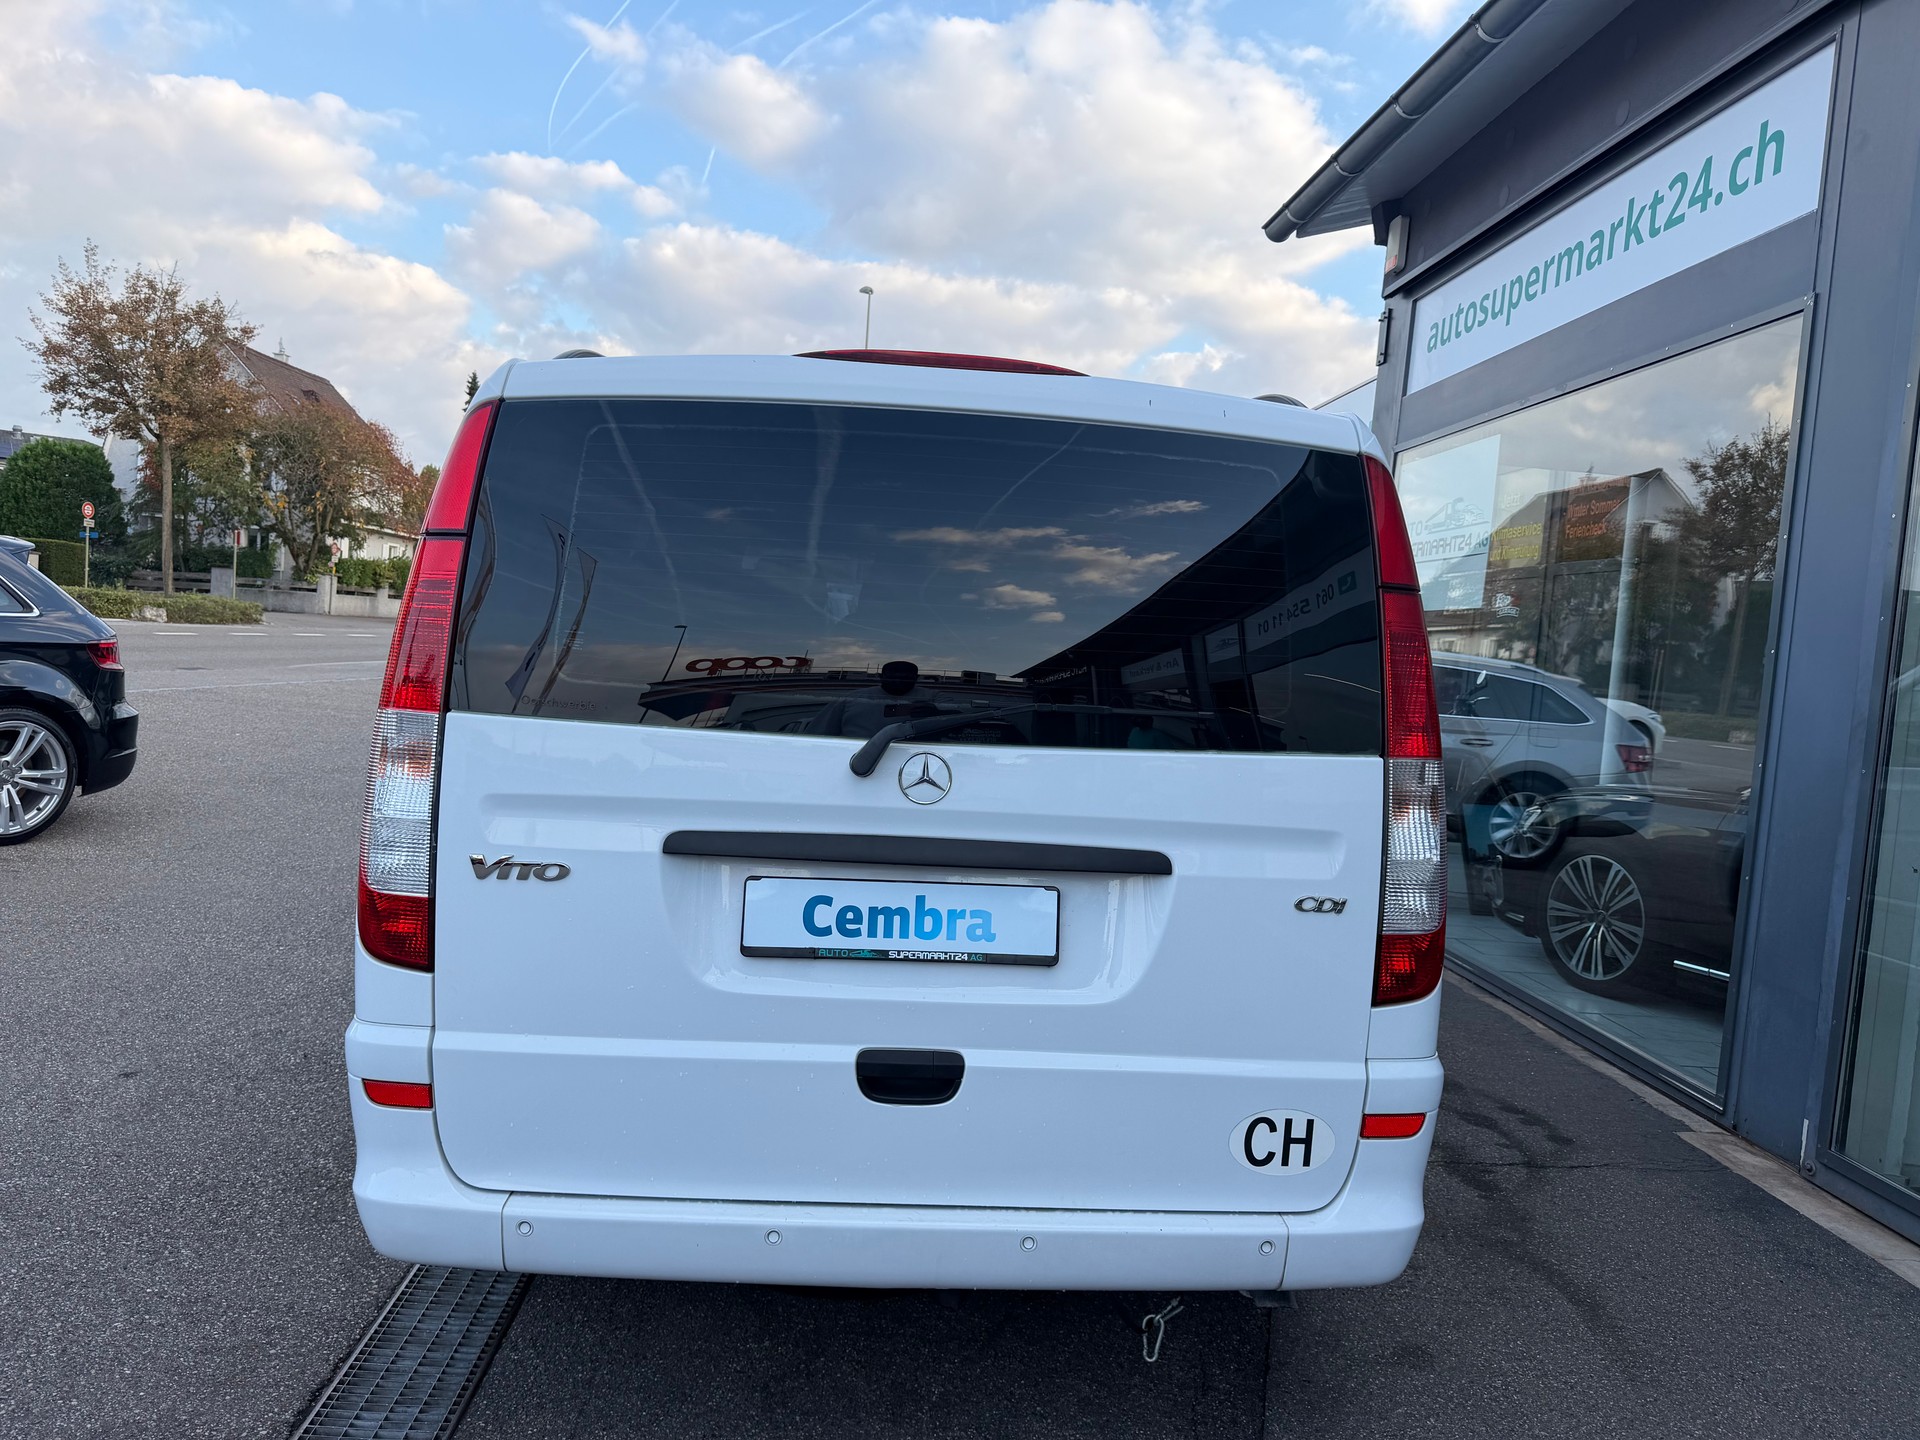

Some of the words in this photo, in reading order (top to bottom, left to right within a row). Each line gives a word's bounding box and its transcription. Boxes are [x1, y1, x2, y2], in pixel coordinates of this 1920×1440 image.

[1426, 119, 1785, 354] autosupermarkt24.ch
[802, 894, 996, 943] Cembra
[818, 948, 849, 958] AUTO
[888, 950, 968, 962] SUPERMARKT24
[970, 953, 983, 962] AG
[1243, 1116, 1315, 1168] CH
